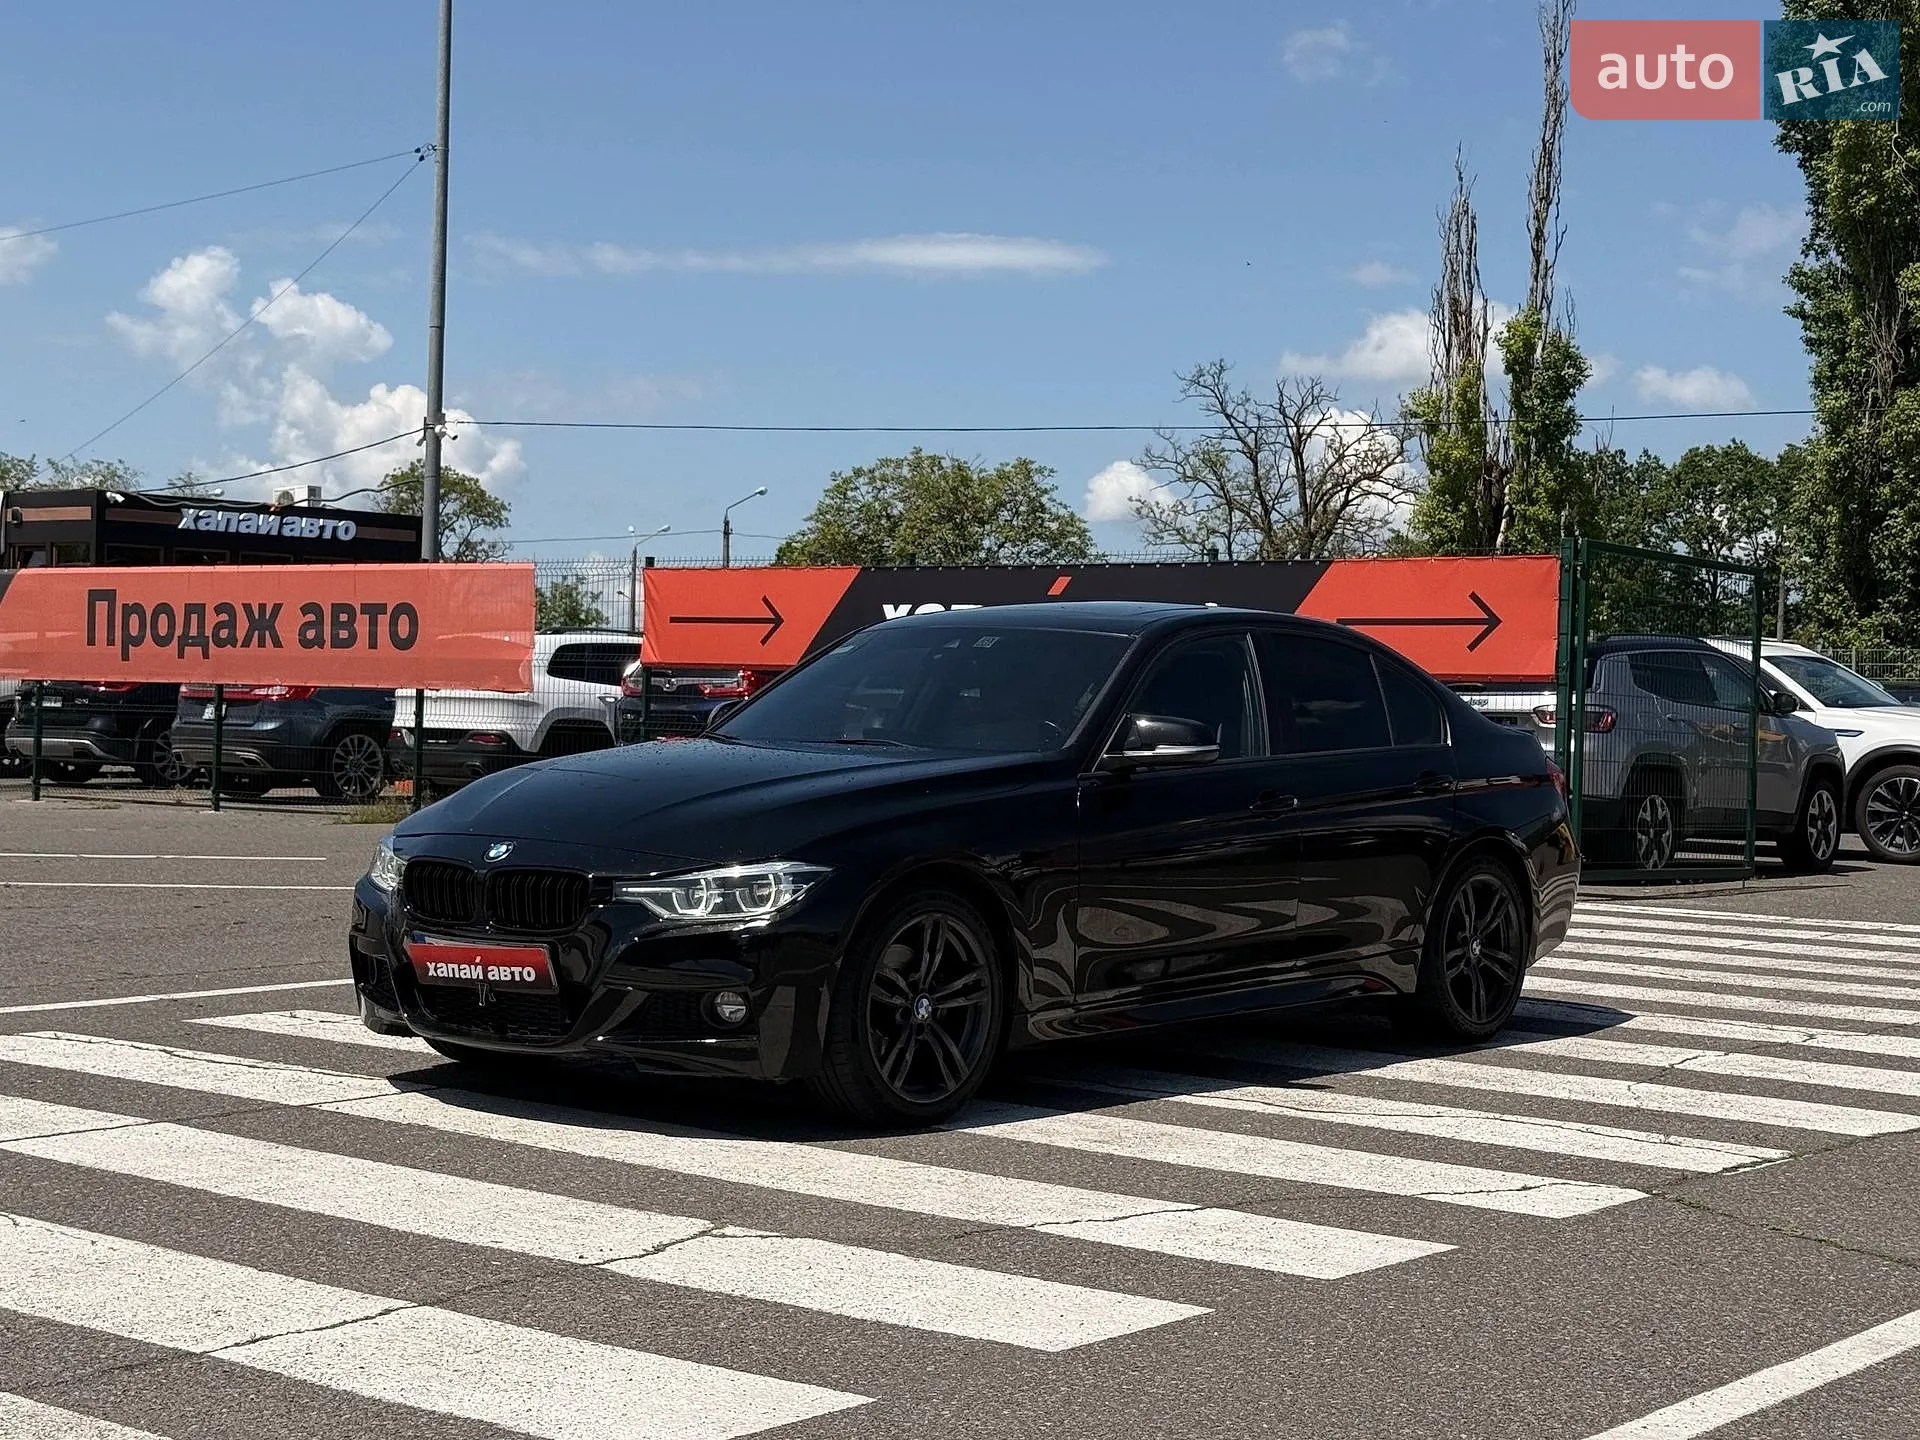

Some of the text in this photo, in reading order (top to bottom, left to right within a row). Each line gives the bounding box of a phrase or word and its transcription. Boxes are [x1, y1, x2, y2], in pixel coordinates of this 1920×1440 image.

[281, 515, 357, 541] авто
[87, 589, 419, 661] Продаж авто
[426, 956, 536, 982] хапай авто
